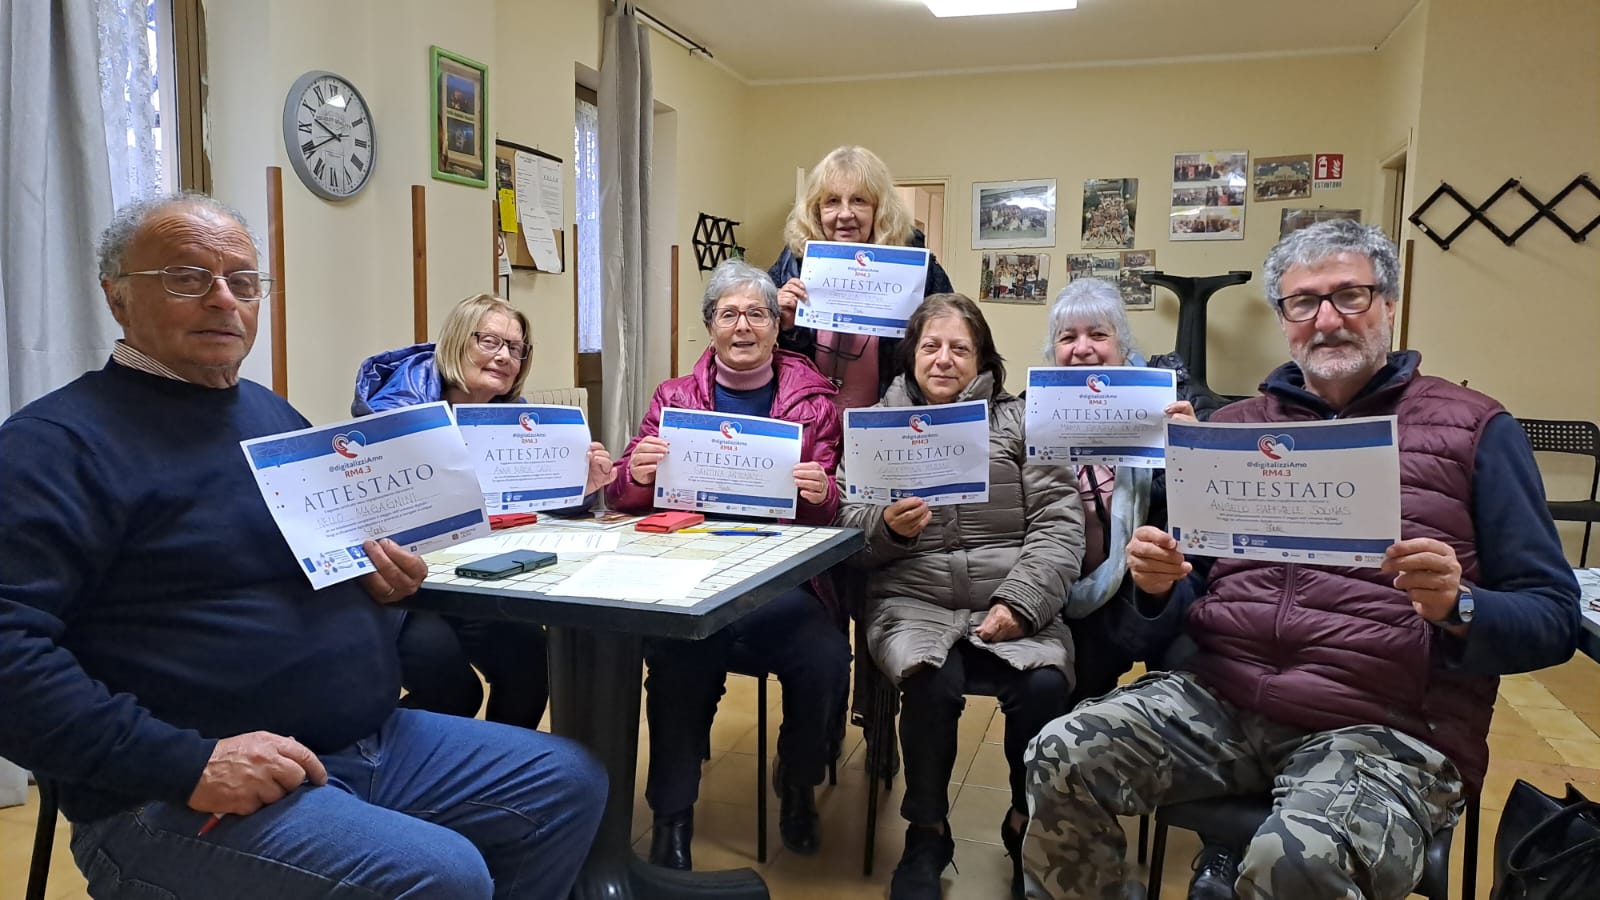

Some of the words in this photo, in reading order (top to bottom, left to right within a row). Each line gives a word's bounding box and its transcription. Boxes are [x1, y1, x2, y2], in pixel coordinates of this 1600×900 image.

[822, 277, 903, 294] ATTESTATO
[1052, 408, 1148, 420] ATTESTATO
[485, 446, 570, 461] ATTESTATO
[683, 450, 774, 469] ATTESTATO
[873, 444, 966, 461] ATTESTATO
[344, 465, 372, 478] RM4.3
[1247, 461, 1308, 470] @digitalizziAmo
[1262, 469, 1292, 477] RM4.3
[304, 463, 434, 513] ATTESTATO
[1205, 479, 1356, 498] ATTESTATO
